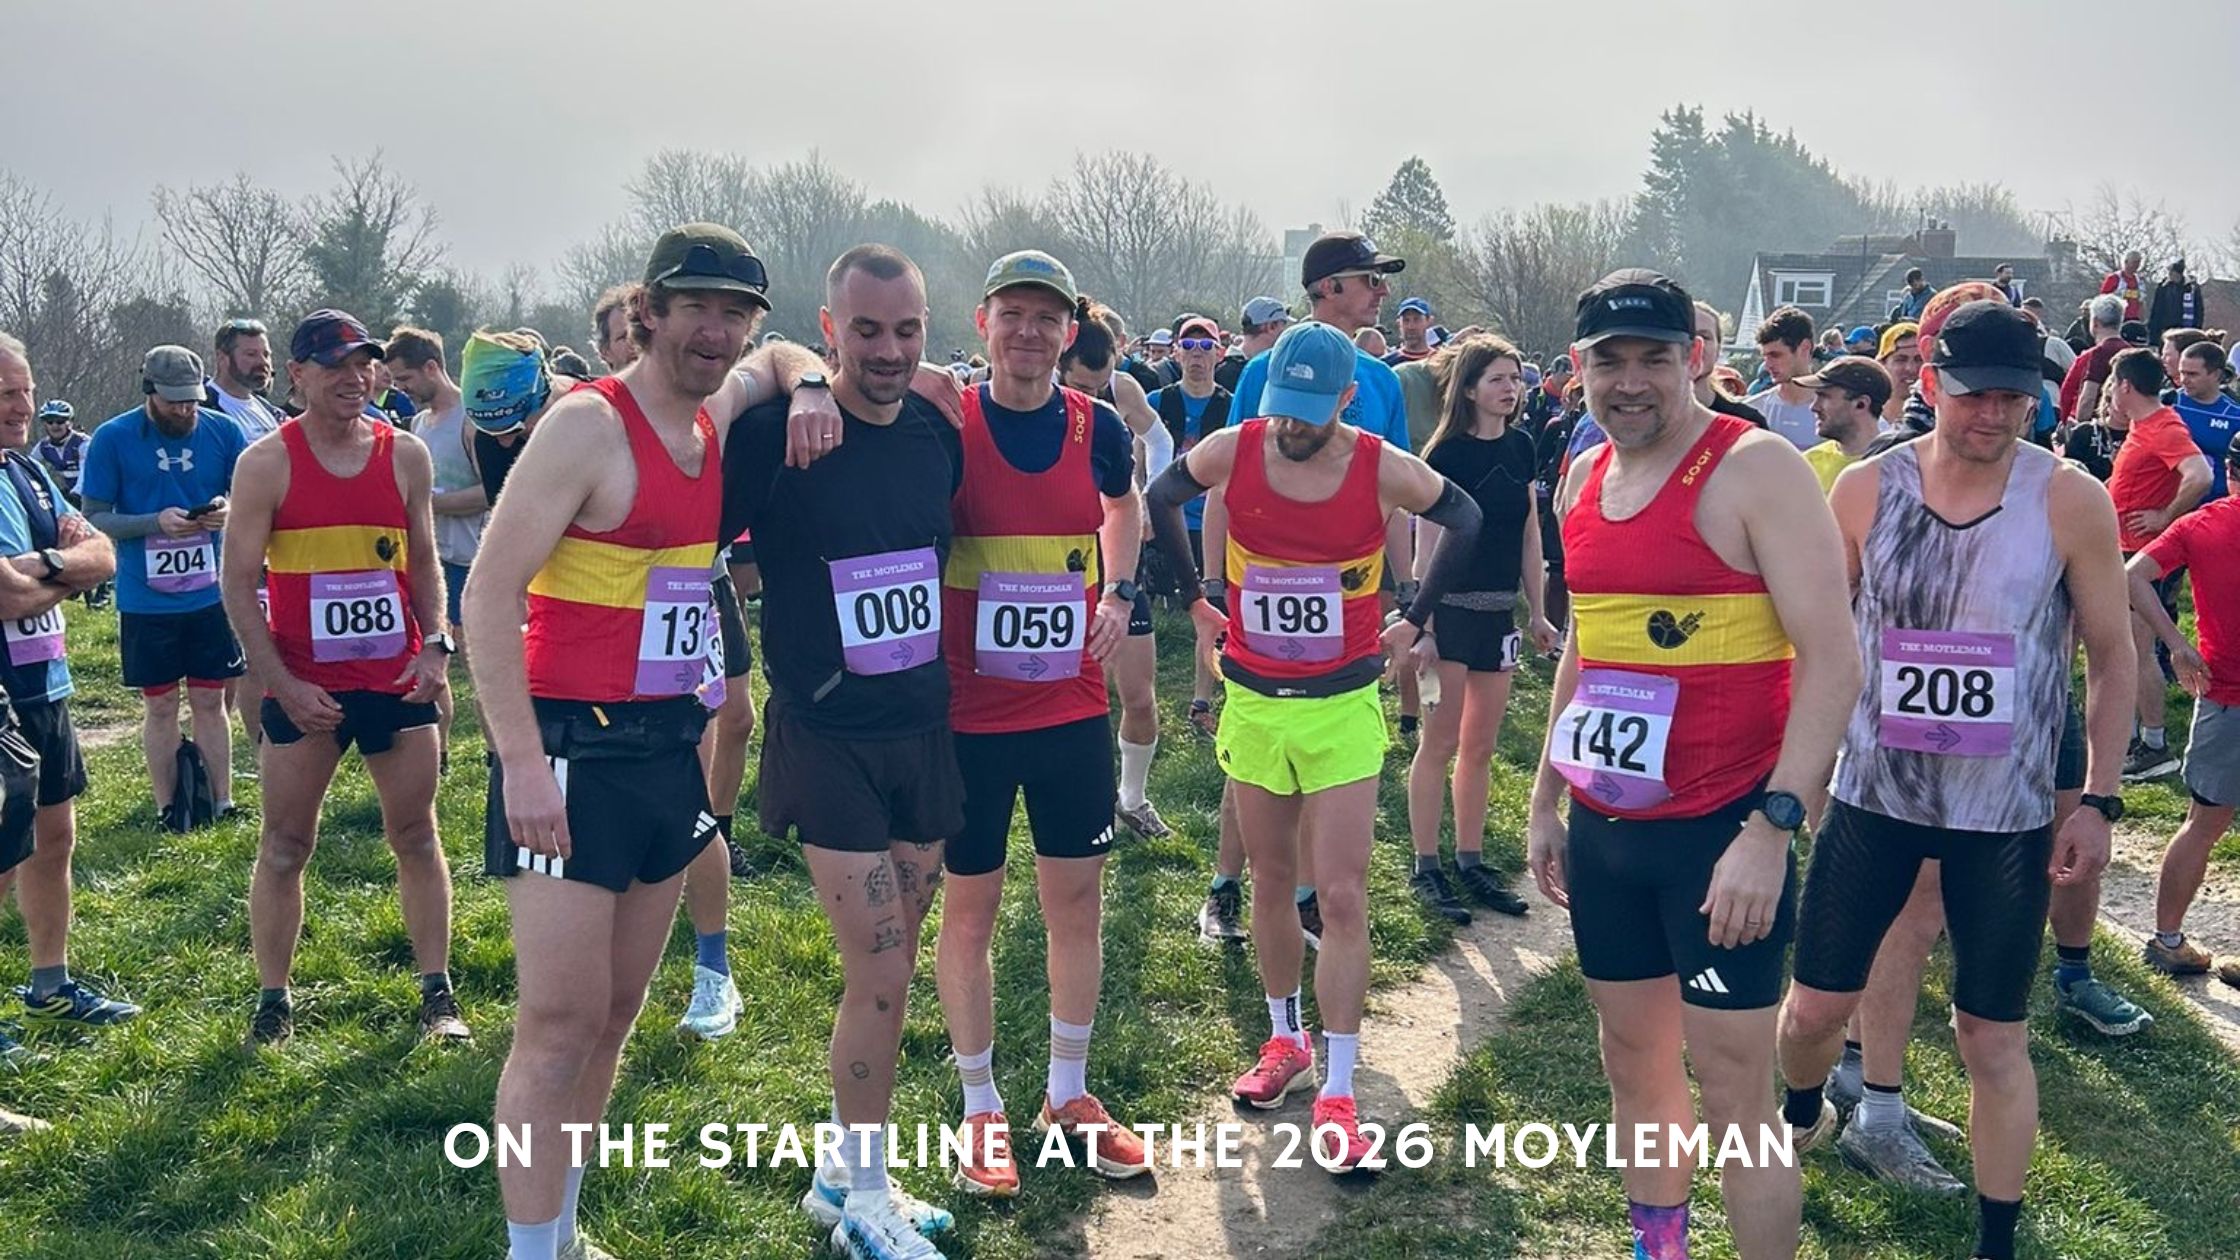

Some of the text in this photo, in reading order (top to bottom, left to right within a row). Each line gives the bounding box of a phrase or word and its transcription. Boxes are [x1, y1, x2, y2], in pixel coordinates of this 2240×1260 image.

[1682, 448, 1712, 486] soar
[156, 547, 206, 574] 204
[852, 561, 924, 580] THE MOYLEMAN
[999, 583, 1073, 593] THE MOYLEMAN
[325, 597, 395, 636] 088
[855, 584, 931, 639] 008
[993, 605, 1074, 649] 059
[1254, 595, 1329, 634] 198
[1899, 642, 1993, 655] THE MOYLEMAN
[1897, 666, 1995, 718] 208
[1571, 709, 1649, 773] 142
